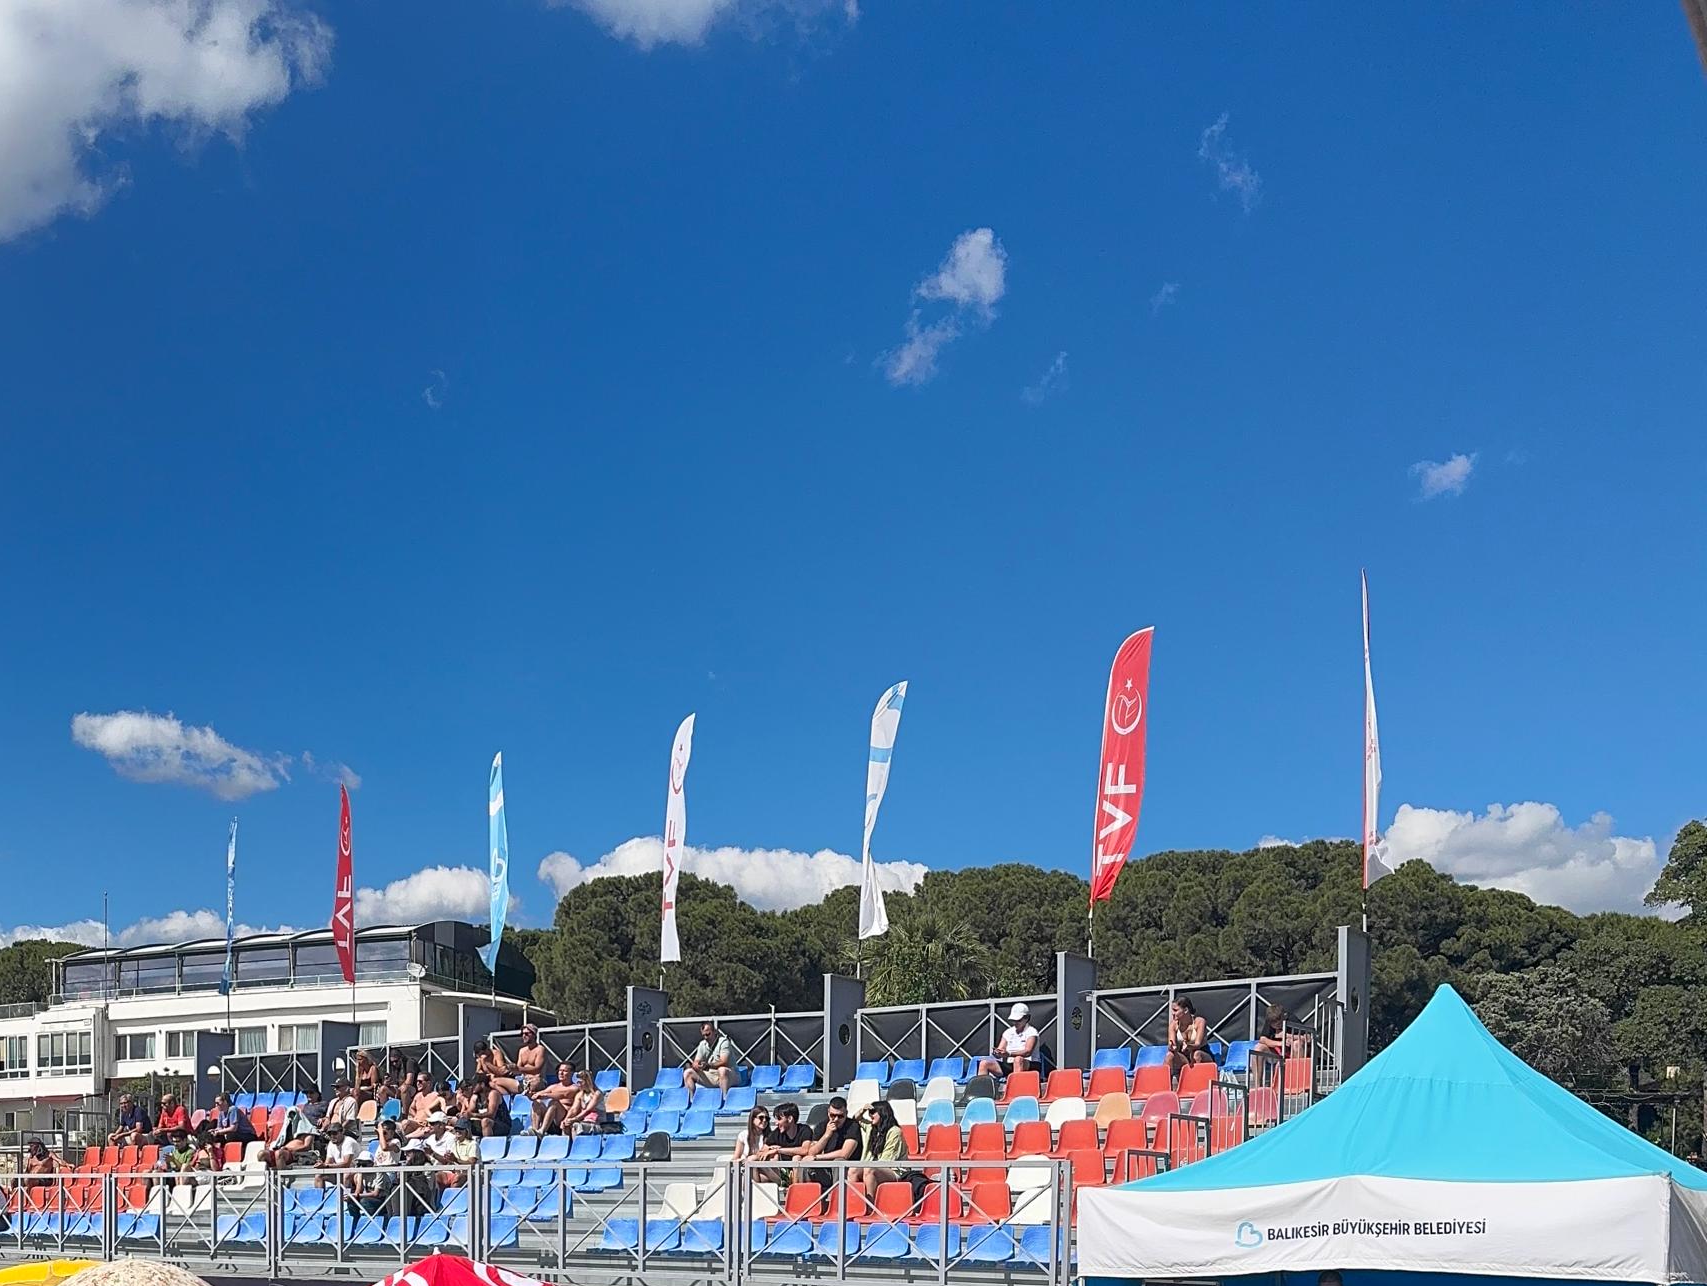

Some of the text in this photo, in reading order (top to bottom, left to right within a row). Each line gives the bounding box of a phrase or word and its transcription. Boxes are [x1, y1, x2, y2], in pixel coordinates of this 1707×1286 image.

[1096, 762, 1136, 877] TVF
[662, 820, 676, 921] TVF
[1267, 1217, 1487, 1241] BALIKESİR BÜYÜKŞEHİR BELEDİYESİ
